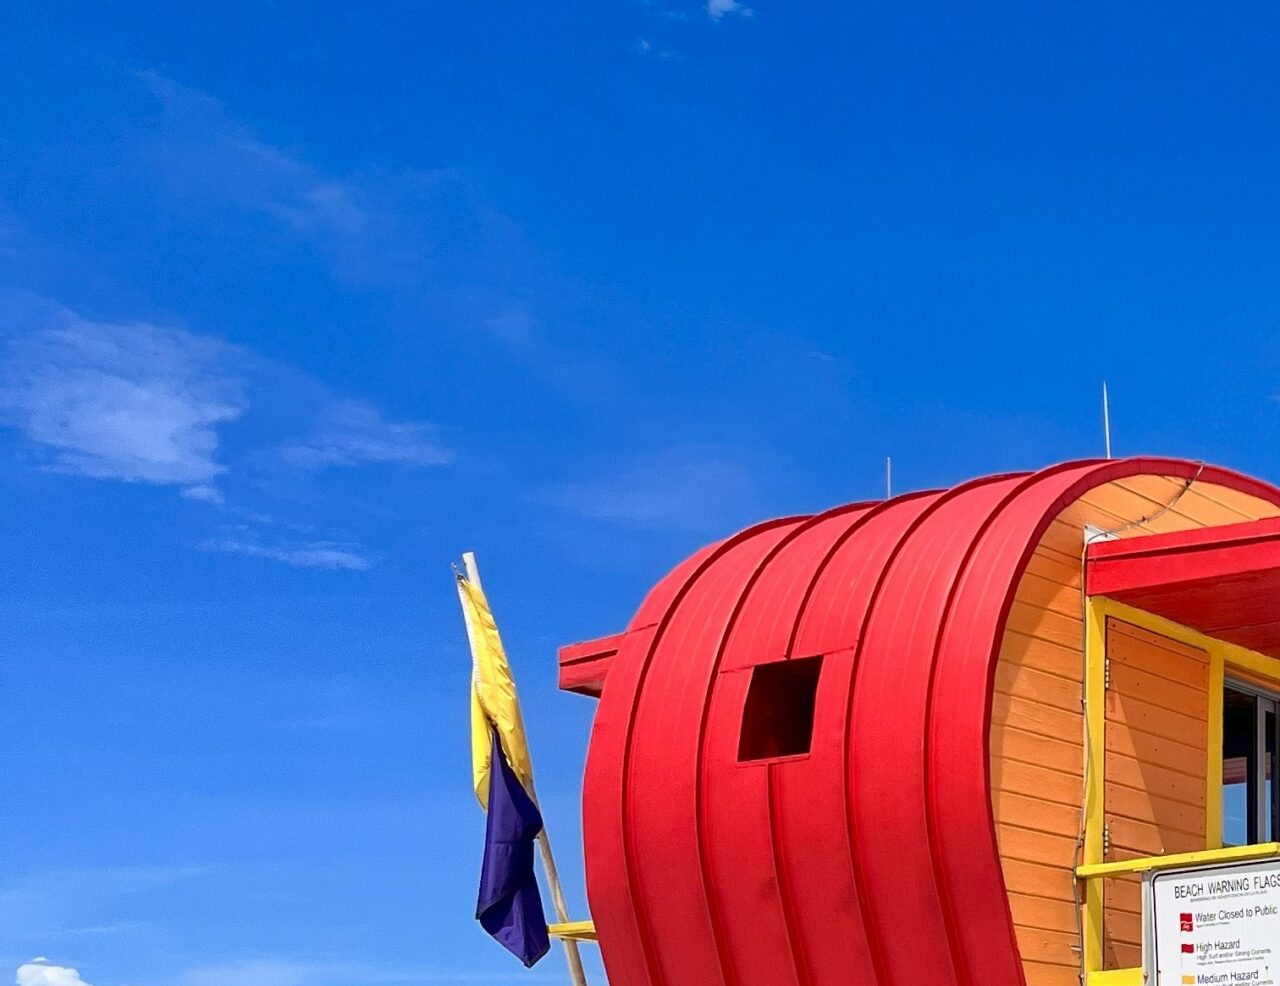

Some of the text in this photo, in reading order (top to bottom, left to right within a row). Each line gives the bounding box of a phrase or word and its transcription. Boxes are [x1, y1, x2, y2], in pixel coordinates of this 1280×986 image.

[1174, 883, 1204, 899] BEACH
[1208, 878, 1250, 895] WARNING
[1195, 904, 1278, 923] Water Closed to Public
[1196, 939, 1240, 954] High Hazard
[1197, 970, 1259, 985] Medium Hazard
